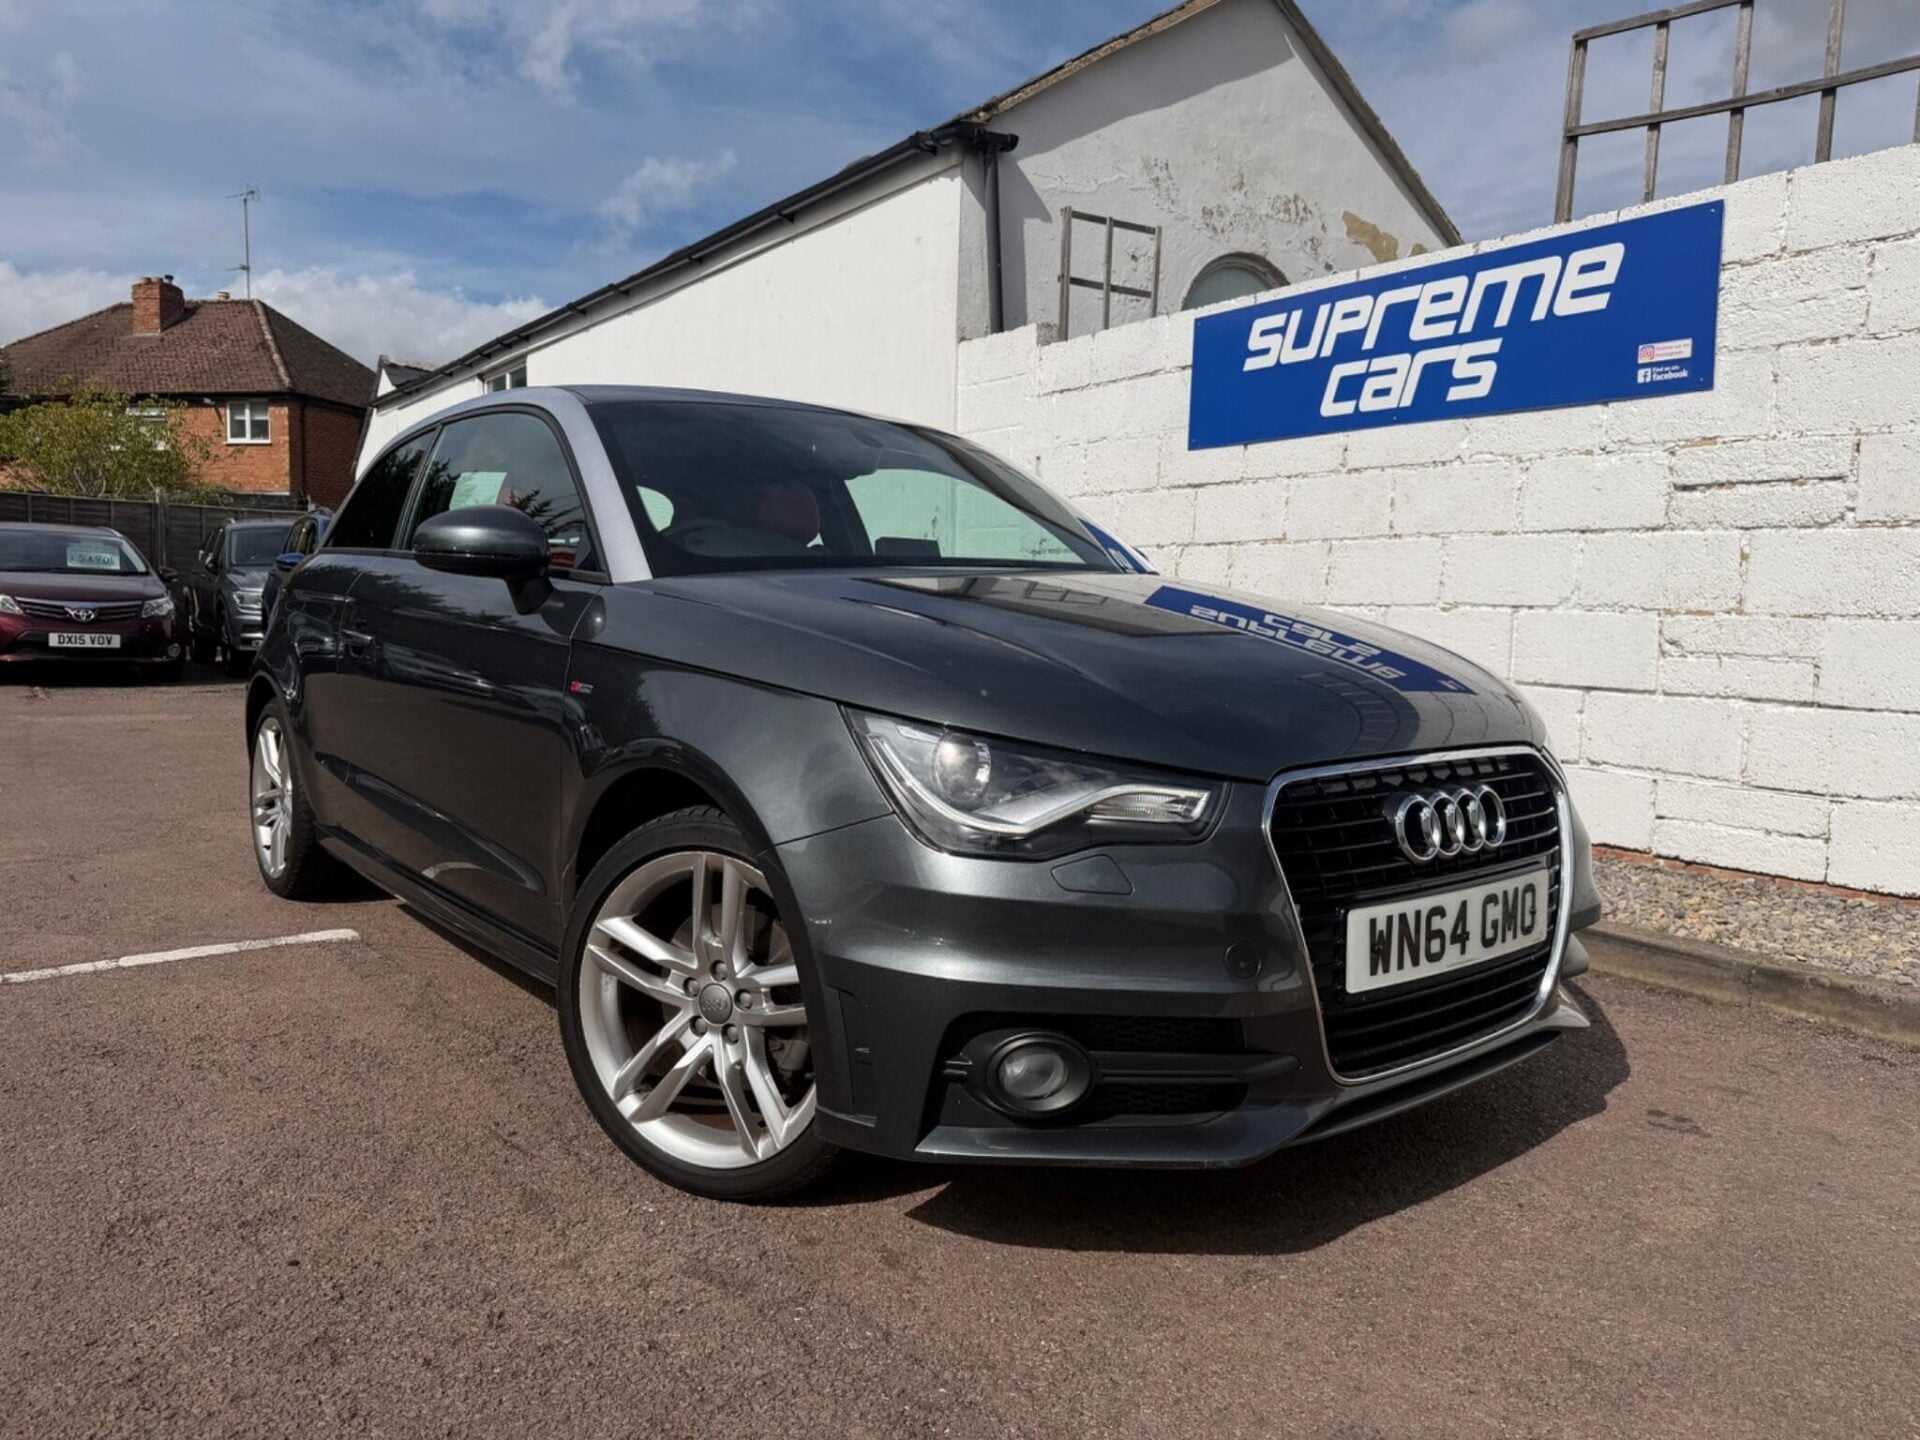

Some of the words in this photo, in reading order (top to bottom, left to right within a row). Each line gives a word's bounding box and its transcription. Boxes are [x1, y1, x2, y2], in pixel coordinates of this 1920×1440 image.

[1320, 337, 1503, 417] cars
[57, 634, 86, 645] DX15
[1369, 900, 1469, 976] WN64
[1480, 882, 1536, 949] GMO
